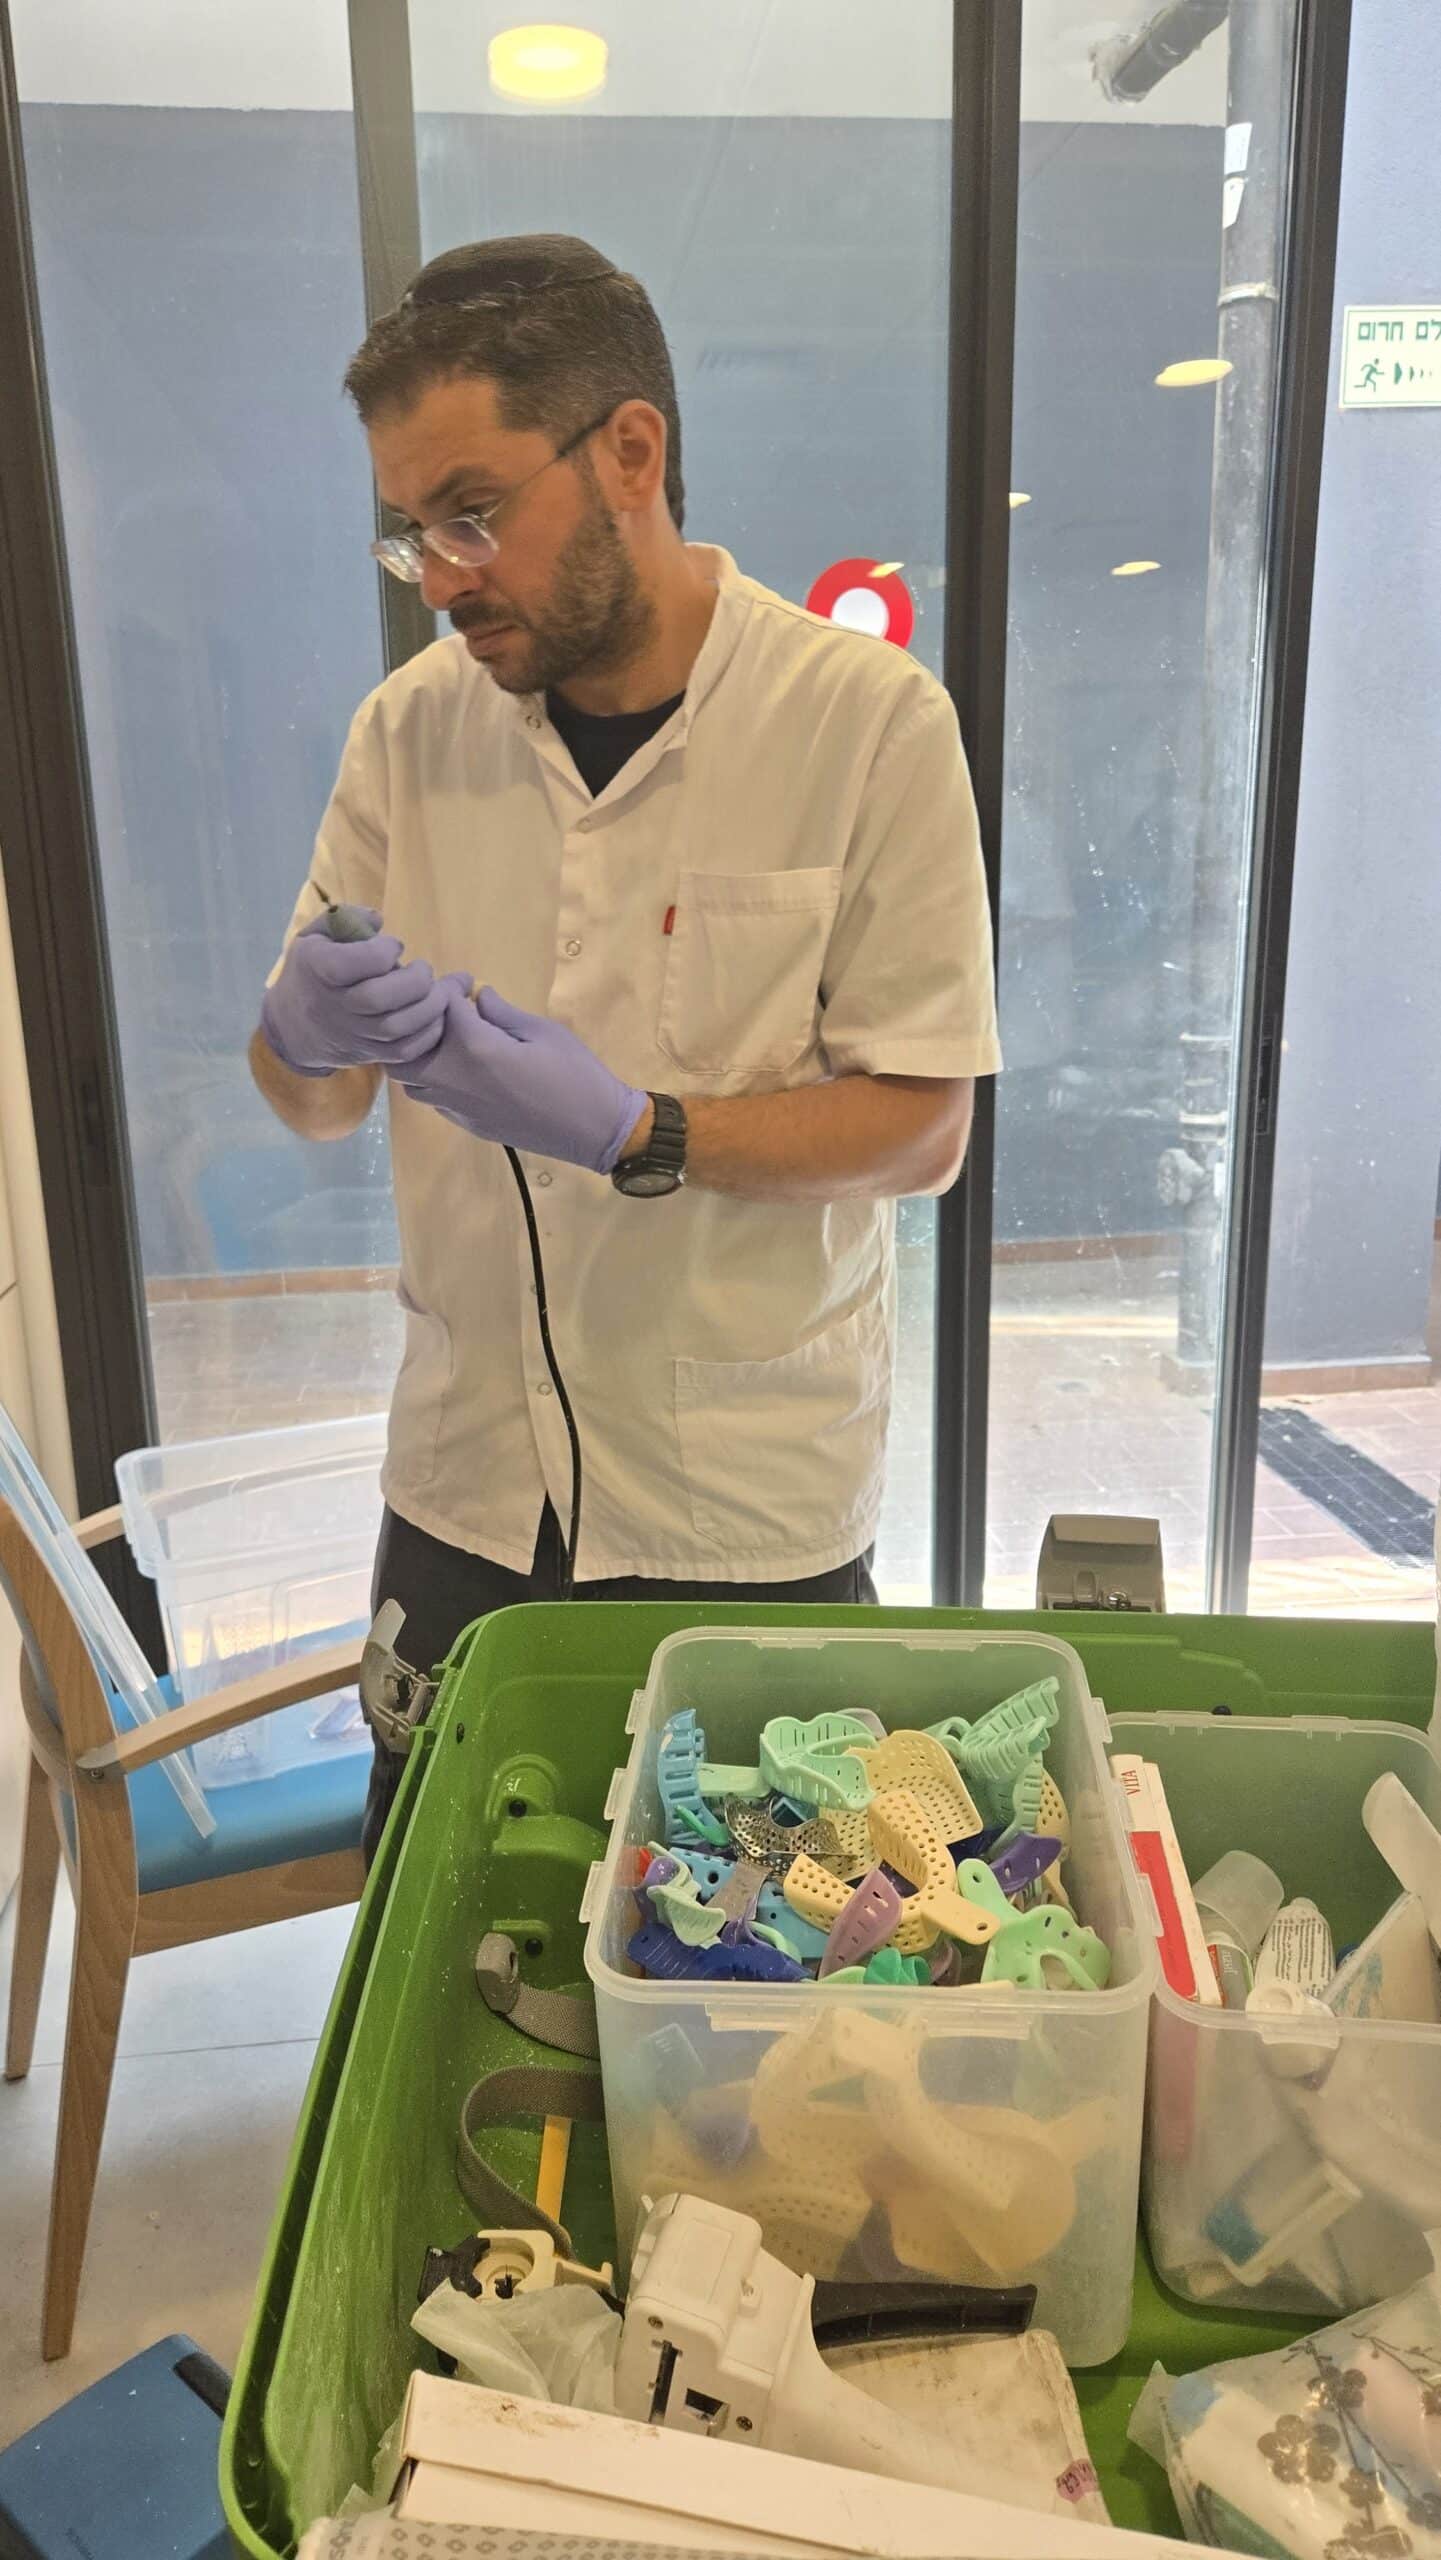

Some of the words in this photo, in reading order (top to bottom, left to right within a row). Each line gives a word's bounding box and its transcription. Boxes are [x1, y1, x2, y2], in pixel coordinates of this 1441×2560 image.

[1358, 321, 1403, 341] חרום
[1415, 319, 1441, 341] לם
[1120, 1769, 1141, 1796] VITA
